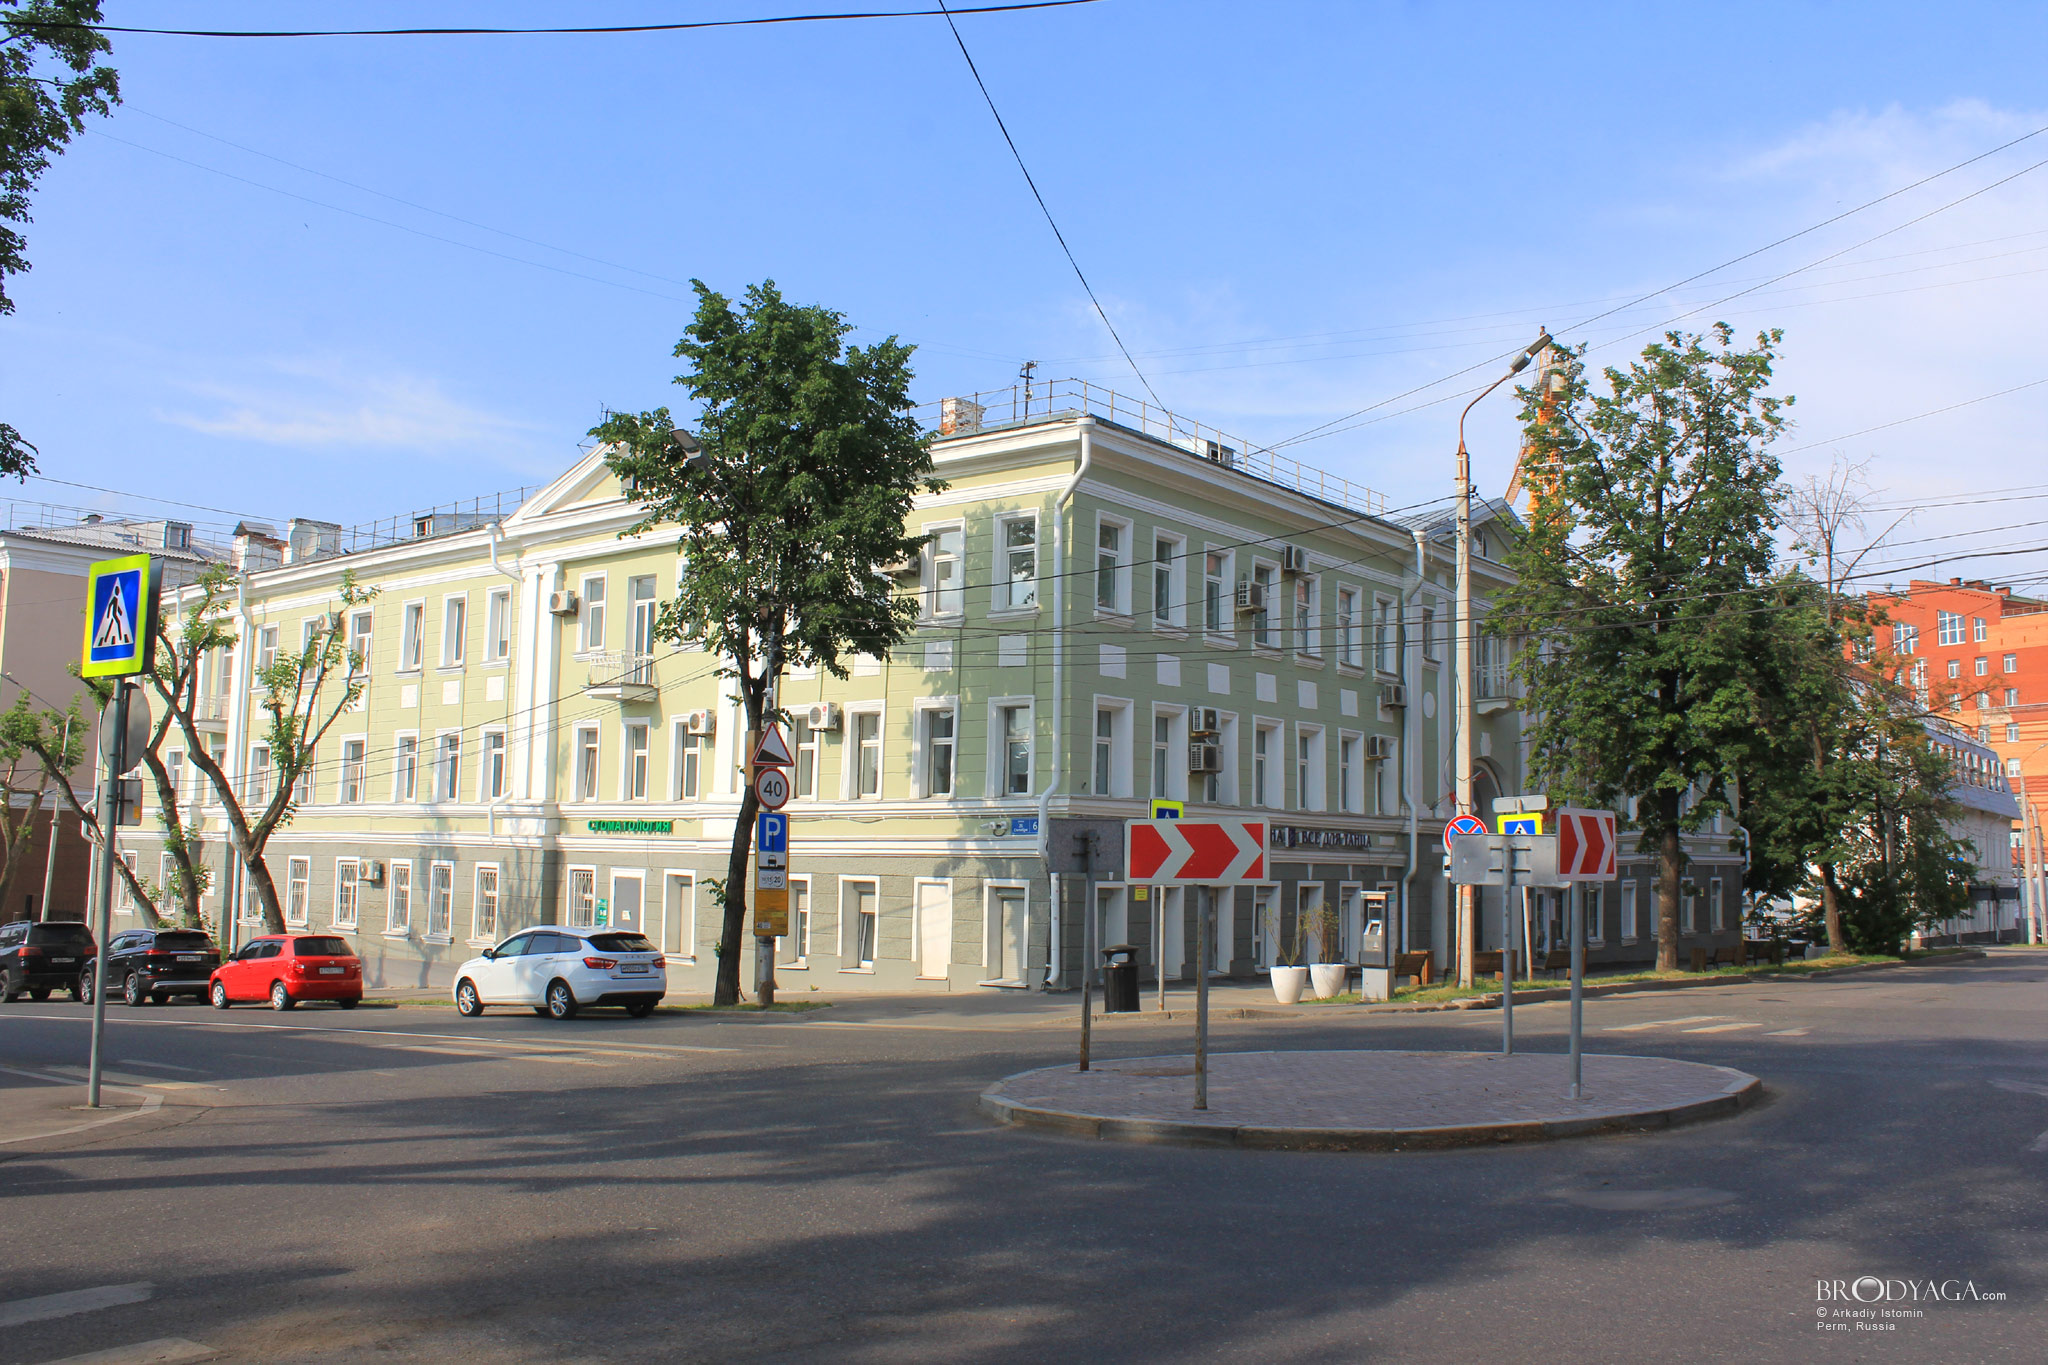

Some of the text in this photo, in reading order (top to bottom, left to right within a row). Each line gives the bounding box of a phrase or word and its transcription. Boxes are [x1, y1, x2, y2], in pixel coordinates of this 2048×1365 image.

[764, 780, 783, 797] 40
[588, 820, 672, 833] СТОМАТОЛОГИЯ
[765, 817, 781, 847] P
[1032, 821, 1038, 830] 6
[1343, 832, 1372, 848] ТАНЦА
